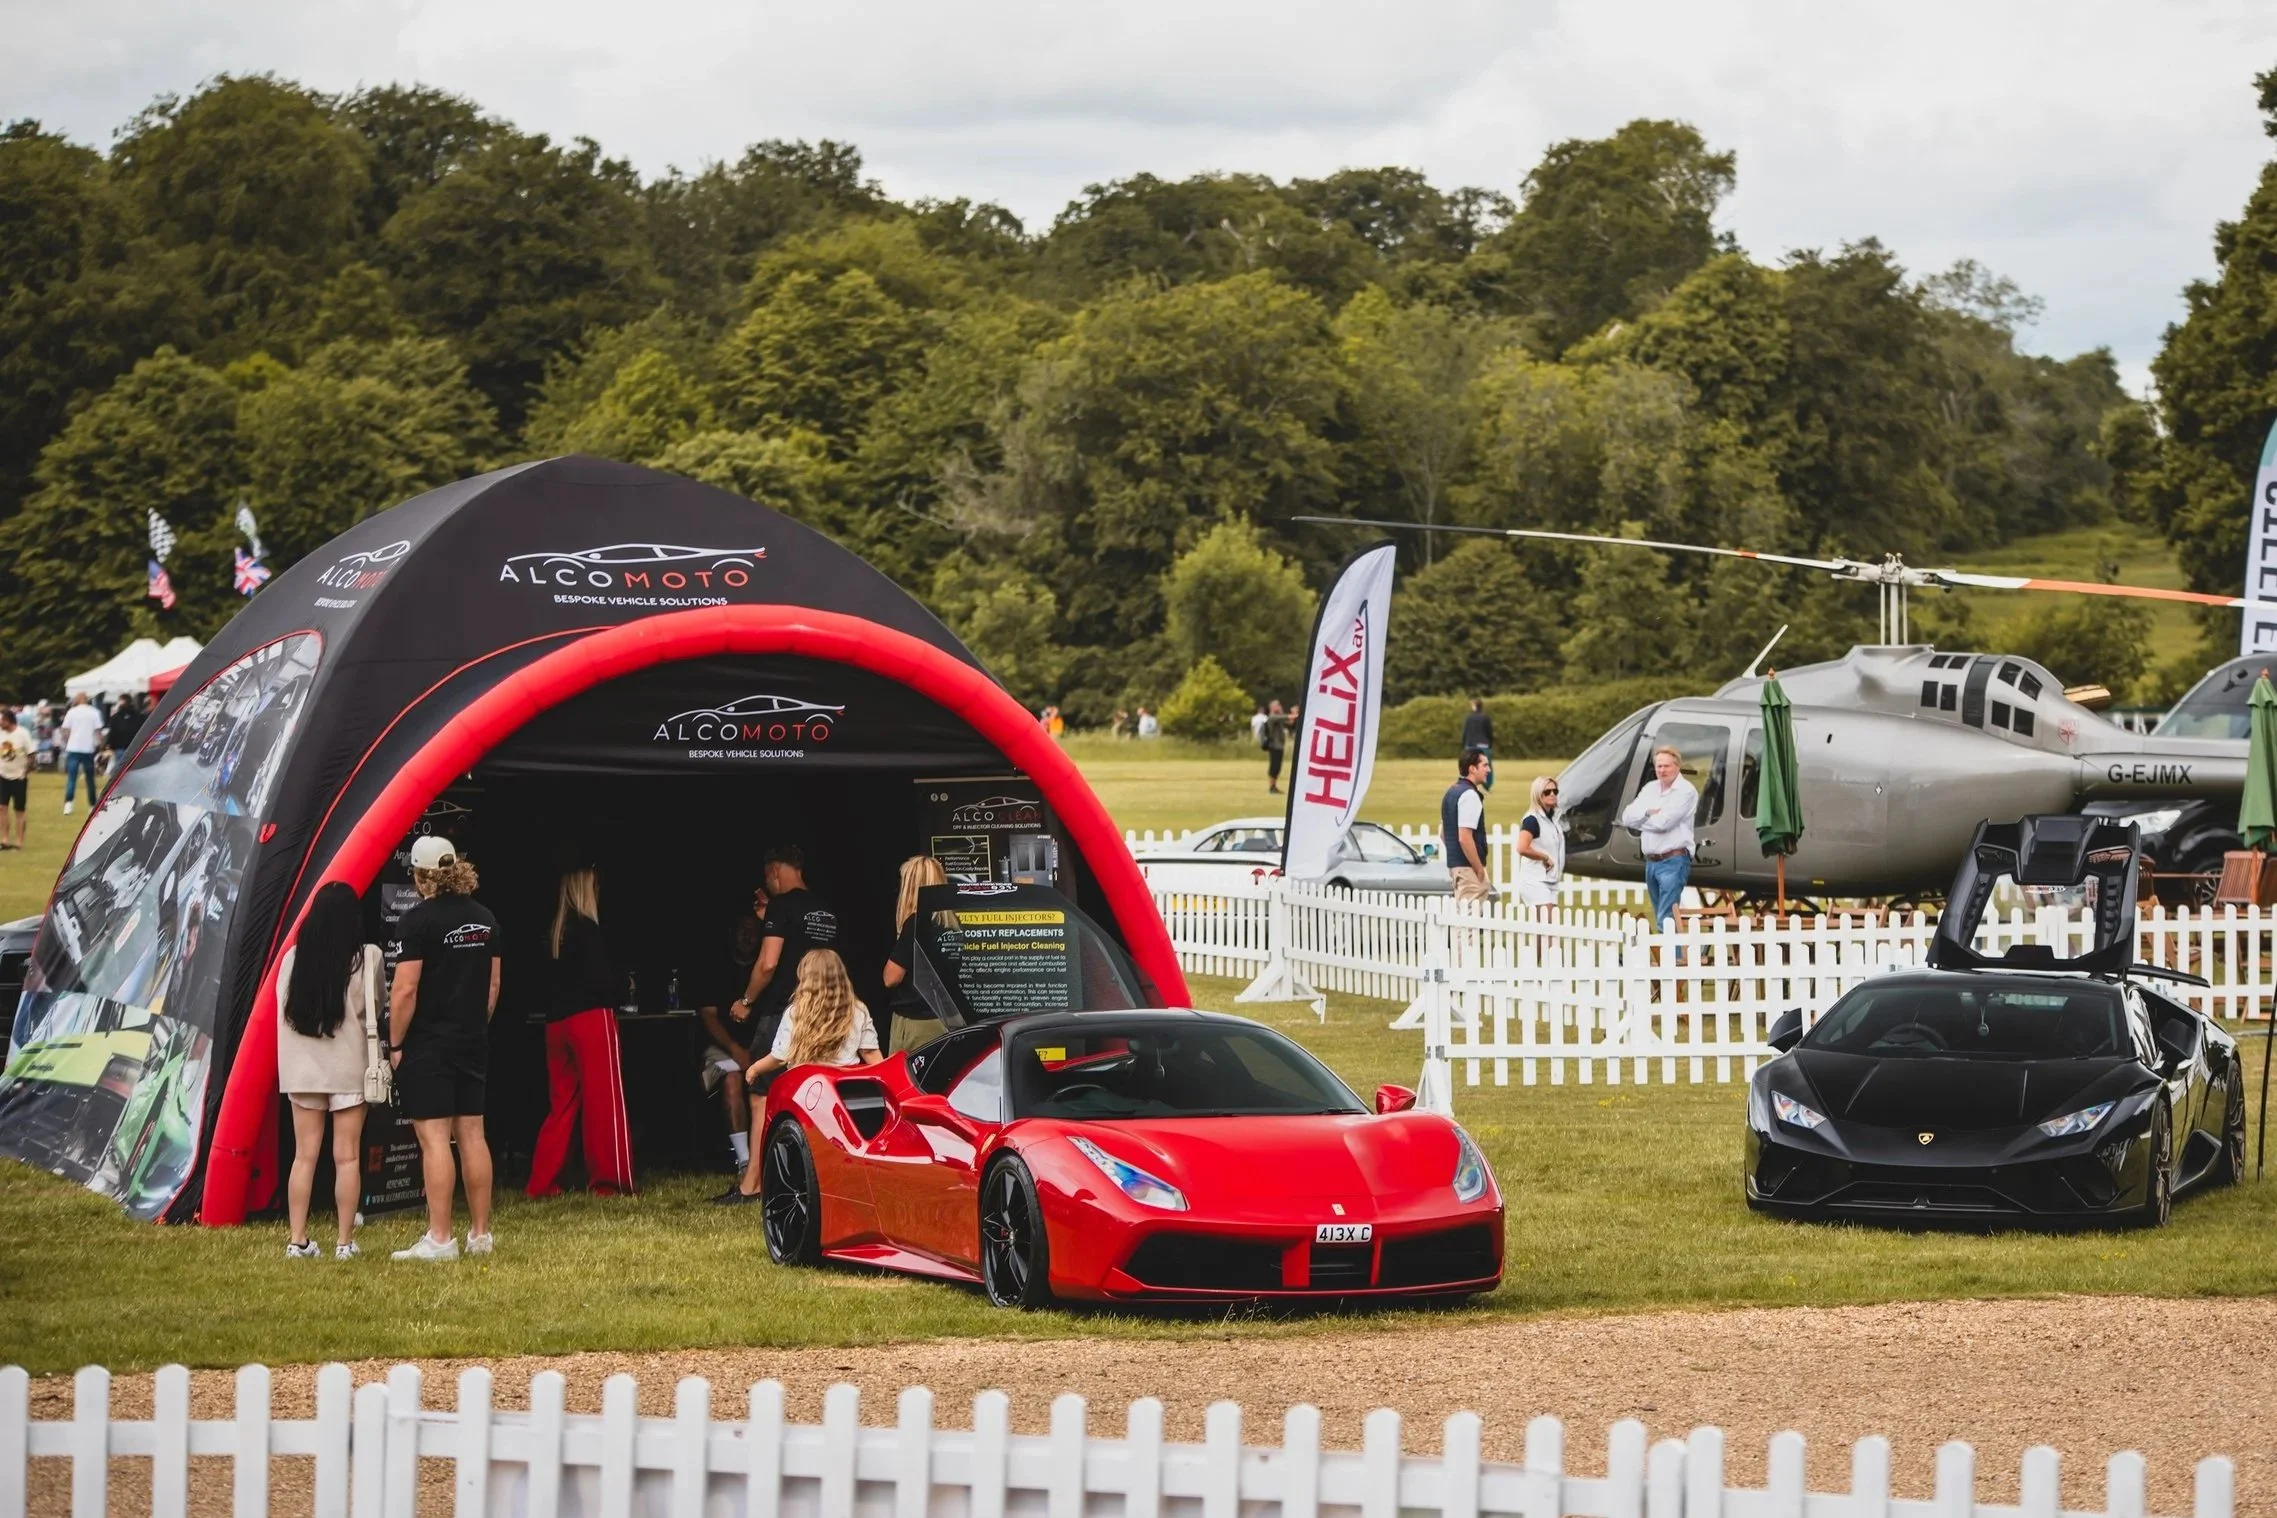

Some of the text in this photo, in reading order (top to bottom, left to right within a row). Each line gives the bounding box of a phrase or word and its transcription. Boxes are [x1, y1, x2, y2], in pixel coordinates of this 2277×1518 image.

[500, 564, 749, 589] ALCOMOTO
[554, 594, 728, 606] BESPOKE VEHICLE SOLUTIONS
[653, 723, 830, 741] ALCOMOTO
[689, 749, 805, 758] BESPOKE VEHICLE SOLUTIONS
[2107, 763, 2192, 784] G-EJMX
[952, 811, 994, 823] ALCO
[982, 913, 1004, 922] FUEL
[1005, 913, 1056, 923] INJECTORS?
[965, 928, 1064, 938] COSTLY REPLACEMENTS
[981, 942, 999, 951] Fuel
[1001, 942, 1030, 952] Injector
[1031, 941, 1066, 952] Cleaning
[1361, 1226, 1370, 1240] C
